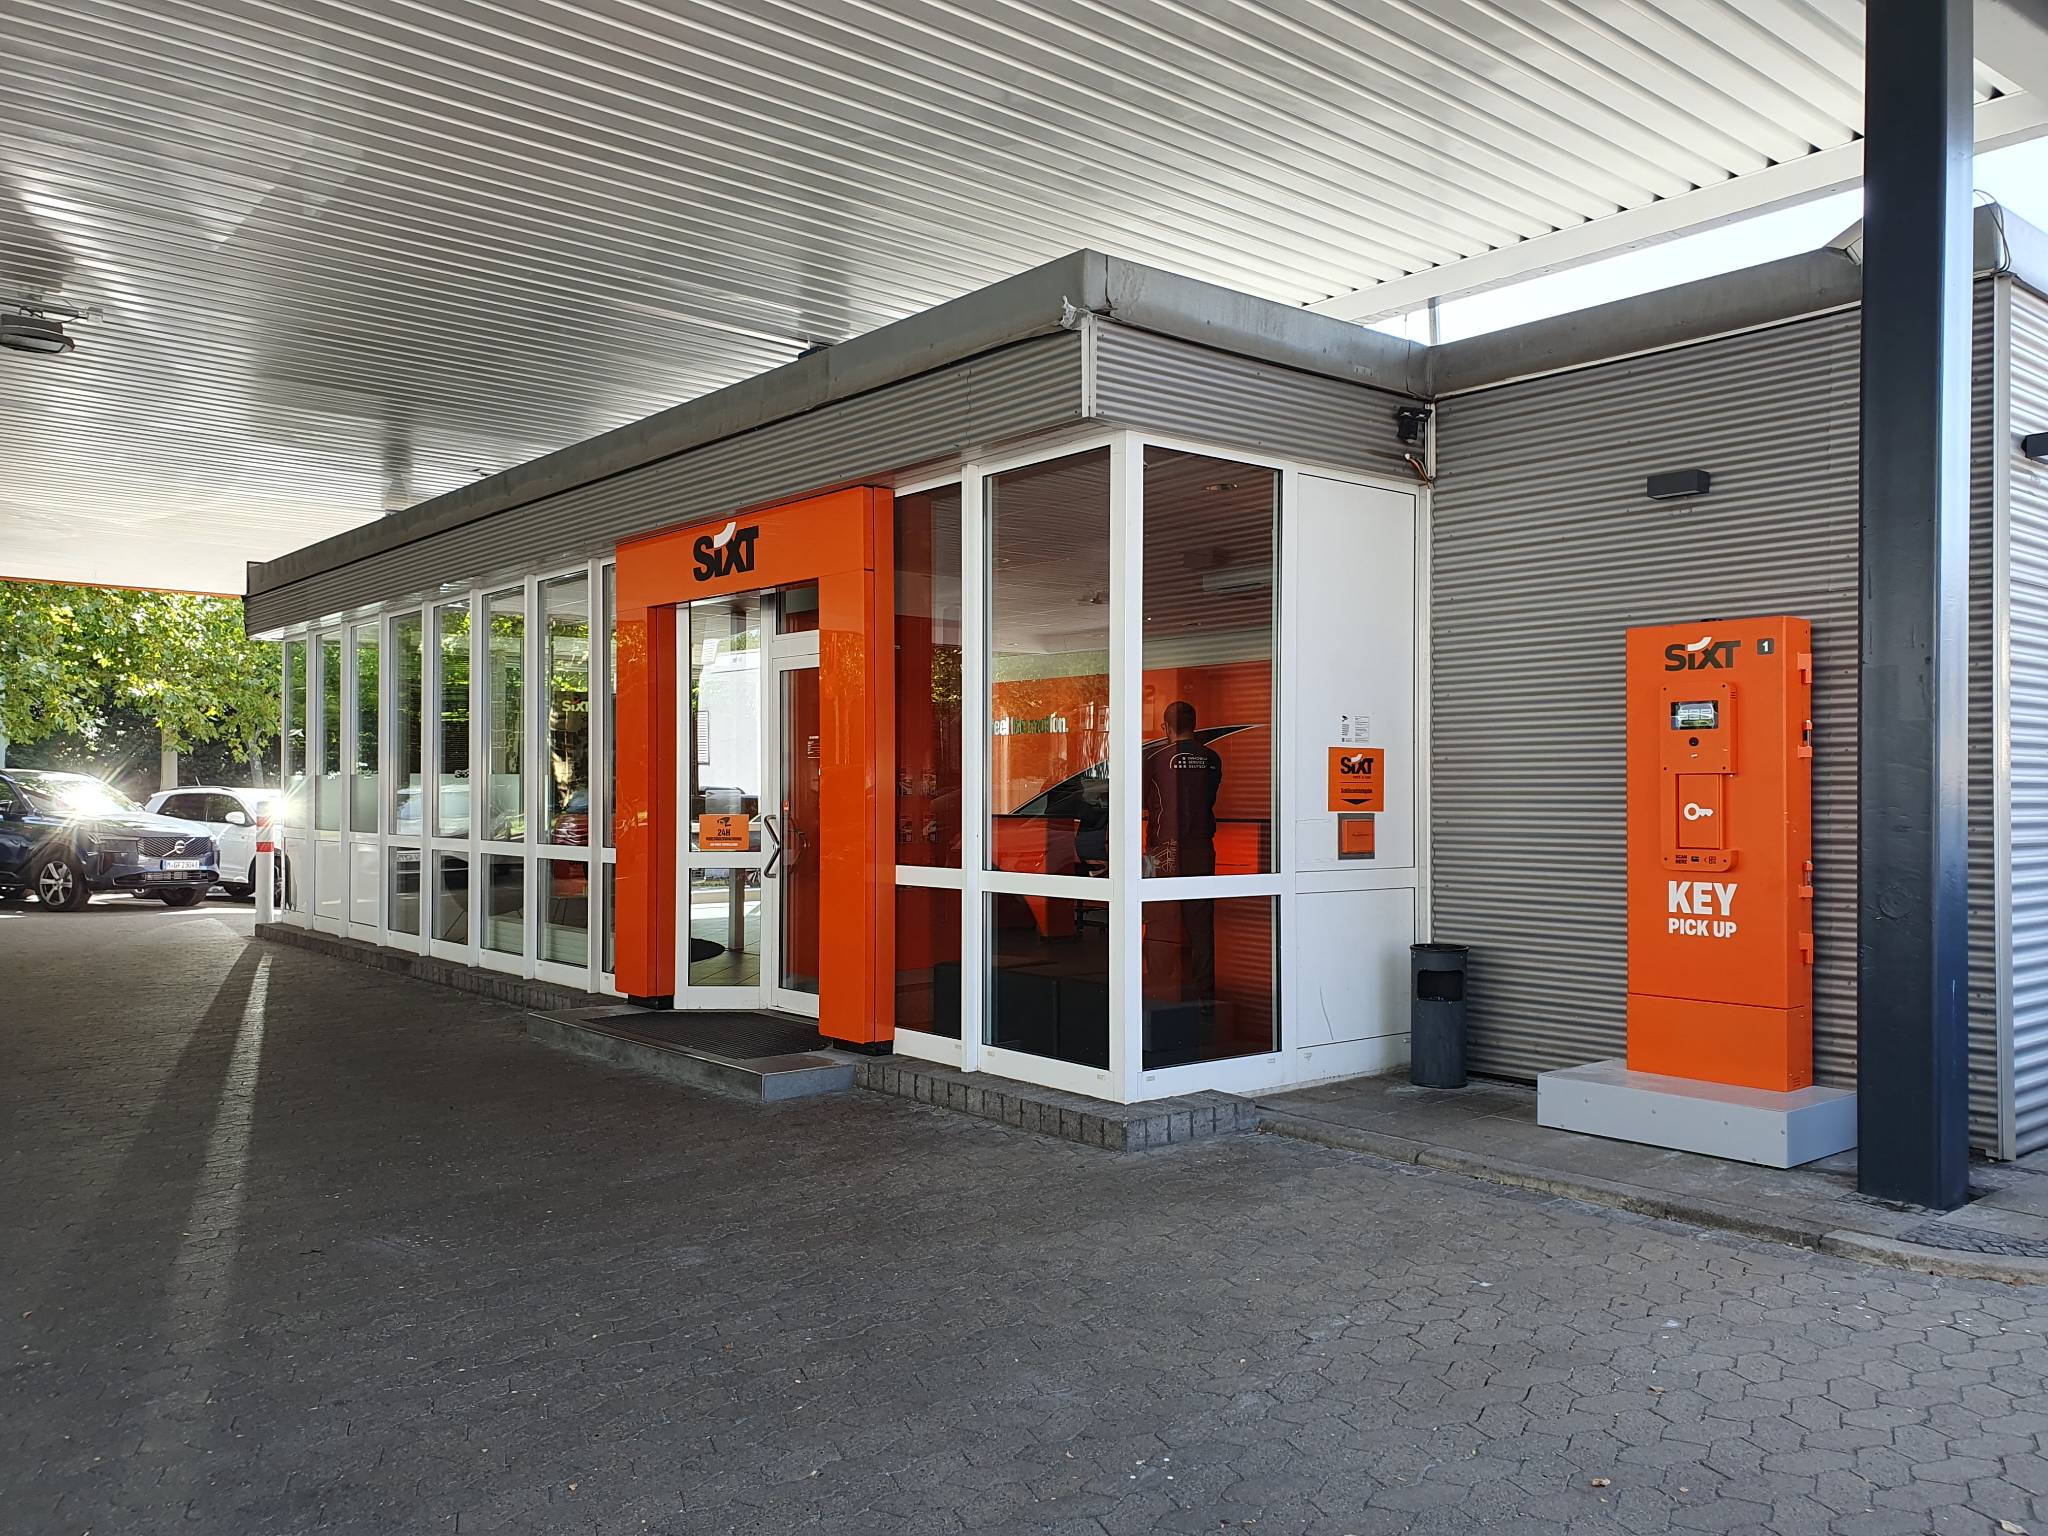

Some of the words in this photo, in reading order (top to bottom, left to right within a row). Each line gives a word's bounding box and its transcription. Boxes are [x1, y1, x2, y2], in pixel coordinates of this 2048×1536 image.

[693, 522, 759, 581] SIXT
[1664, 637, 1741, 671] SIXT
[1762, 641, 1769, 652] 1
[1340, 754, 1374, 774] SIXT
[1668, 880, 1738, 916] KEY
[1668, 917, 1709, 937] PICK
[1713, 920, 1737, 938] UP
